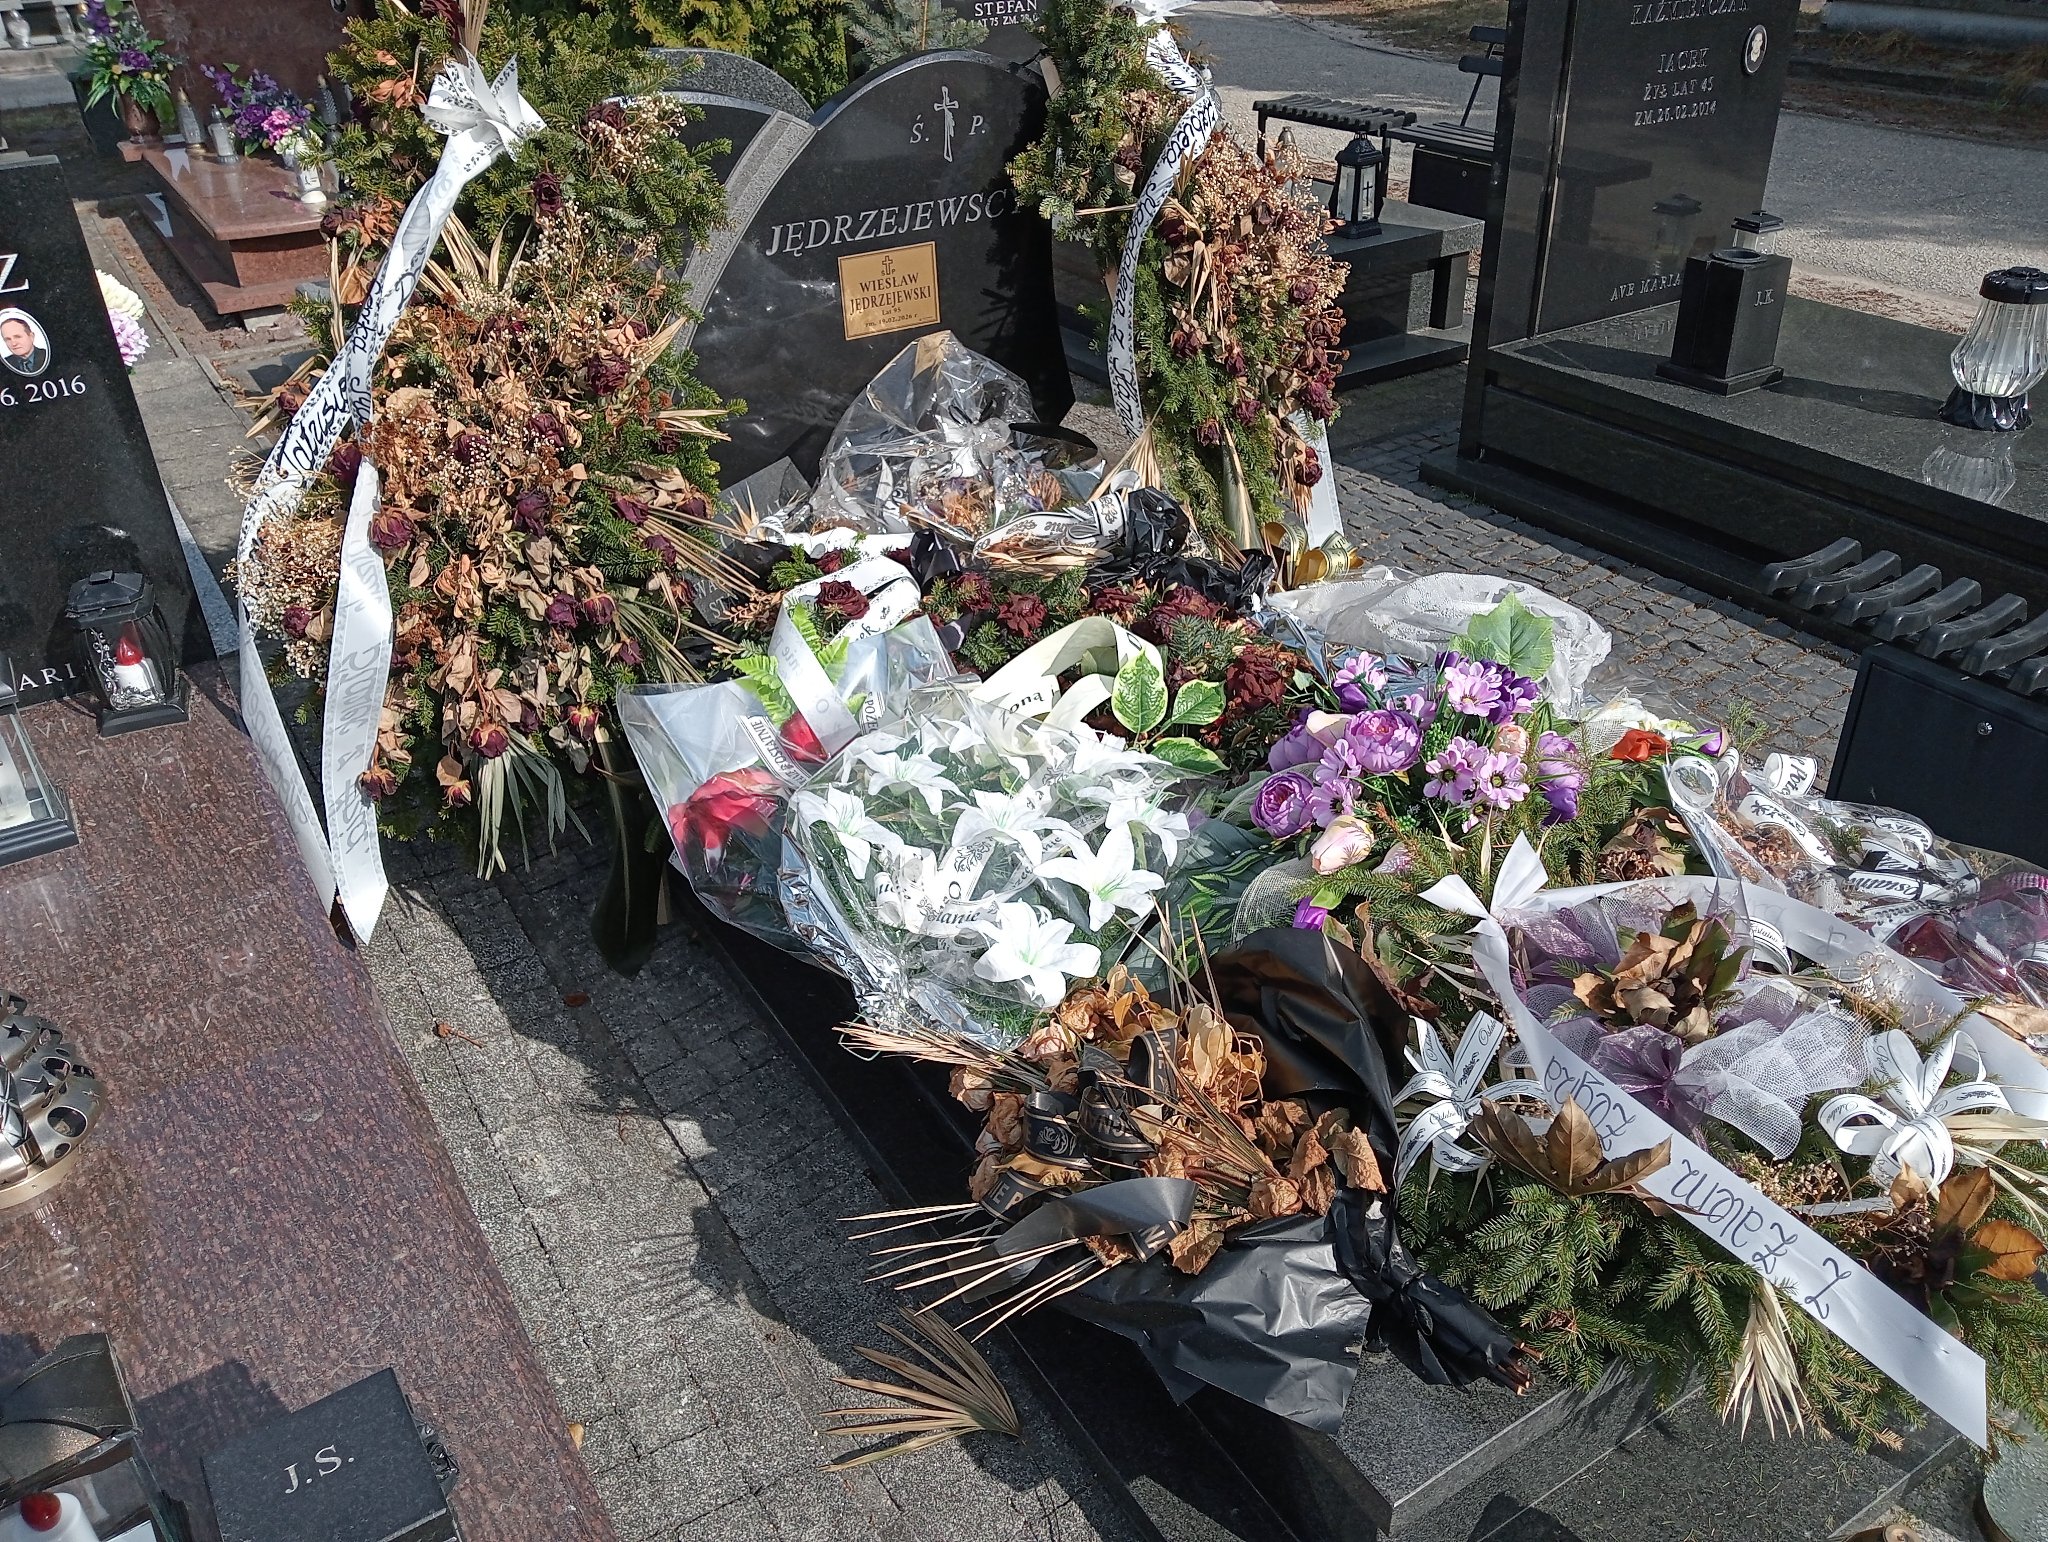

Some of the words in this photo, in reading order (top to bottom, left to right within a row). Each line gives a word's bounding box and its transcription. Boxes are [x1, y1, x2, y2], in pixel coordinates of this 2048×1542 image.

[975, 0, 1037, 17] STEFAN
[1657, 47, 1709, 74] JACEK
[1672, 79, 1698, 97] LAT
[765, 189, 1021, 257] JĘDRZEJEWSC
[859, 272, 919, 294] WIESŁAW
[1610, 282, 1635, 302] AVE
[850, 285, 932, 316] JĘDRZEJEWSKI
[25, 374, 87, 403] 2016
[283, 1444, 355, 1494] J.S.
